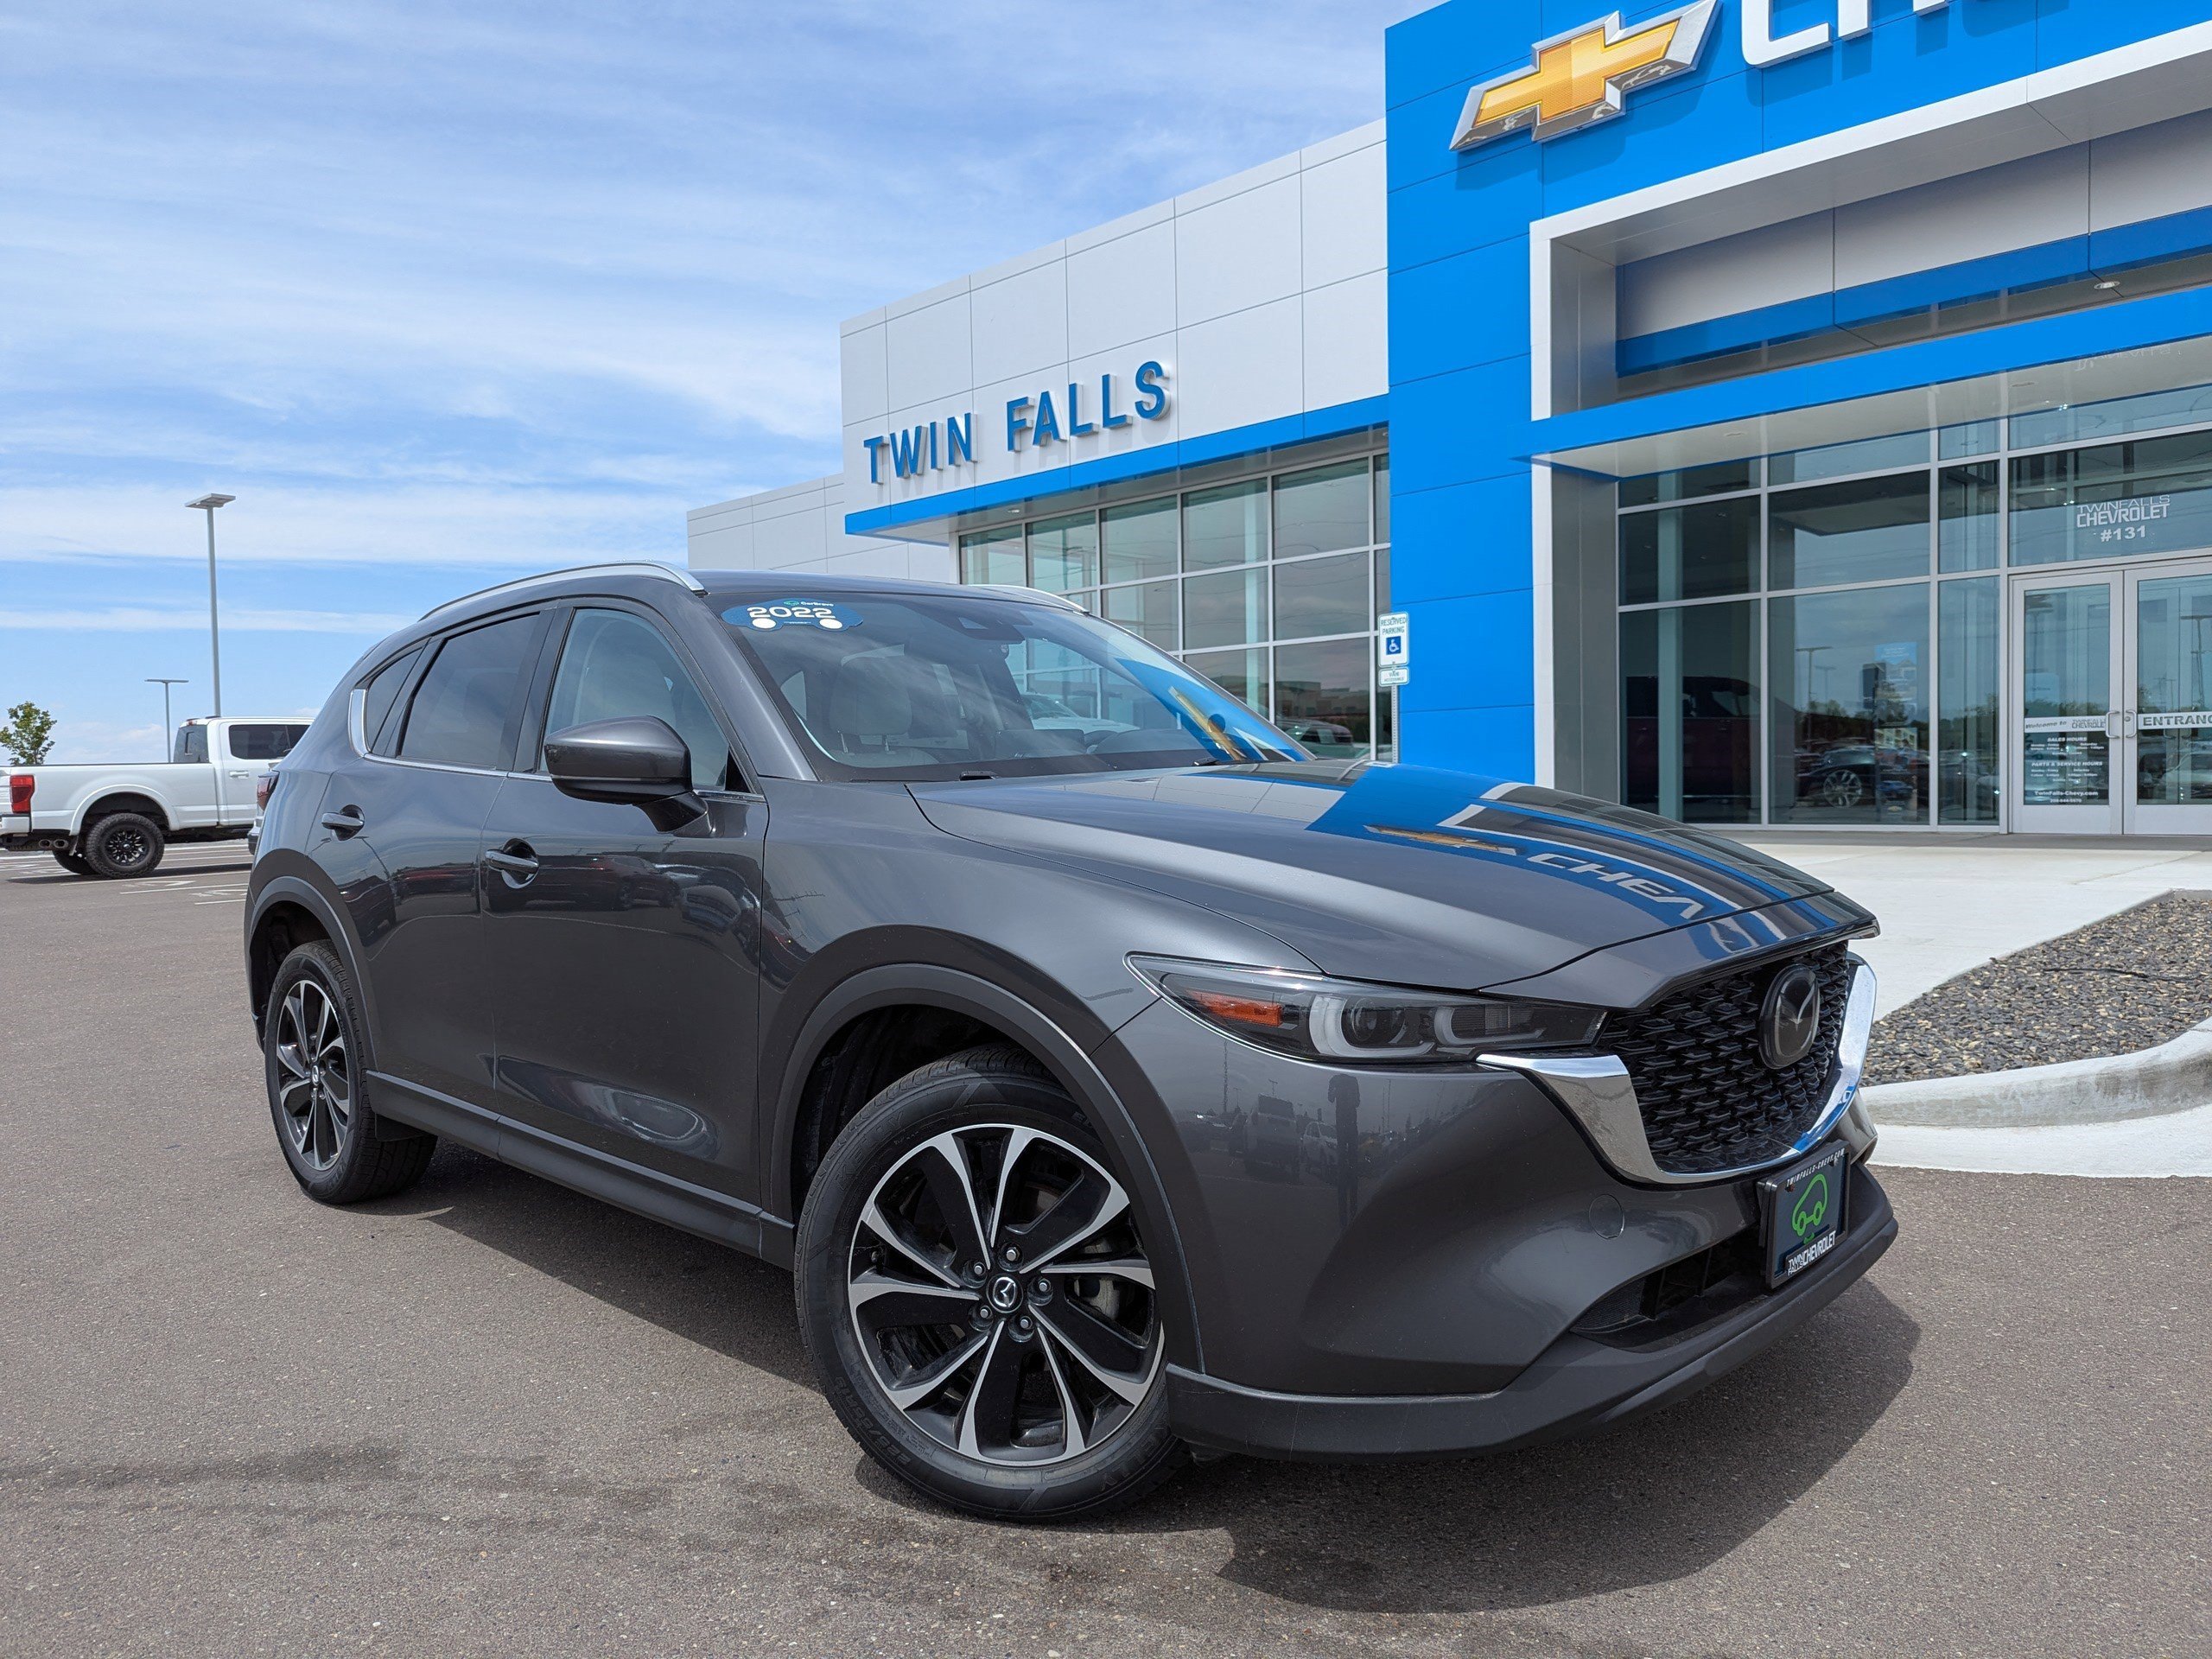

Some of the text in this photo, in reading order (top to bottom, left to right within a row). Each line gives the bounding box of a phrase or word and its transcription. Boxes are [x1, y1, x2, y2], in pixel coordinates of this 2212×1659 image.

[864, 361, 1170, 484] TWIN FALLS
[2077, 494, 2170, 513] TWINFALLS
[2076, 504, 2170, 528] CHEVROLET
[2101, 525, 2145, 542] #131
[747, 607, 836, 619] 2022
[1381, 617, 1407, 626] RESERVED
[1382, 626, 1404, 635] PARKING
[1786, 1147, 1846, 1187] TWINFALLS-CHEVY.COM
[1788, 1230, 1836, 1268] TWIN CHEVROLET
[1788, 1260, 1803, 1276] FALLS
